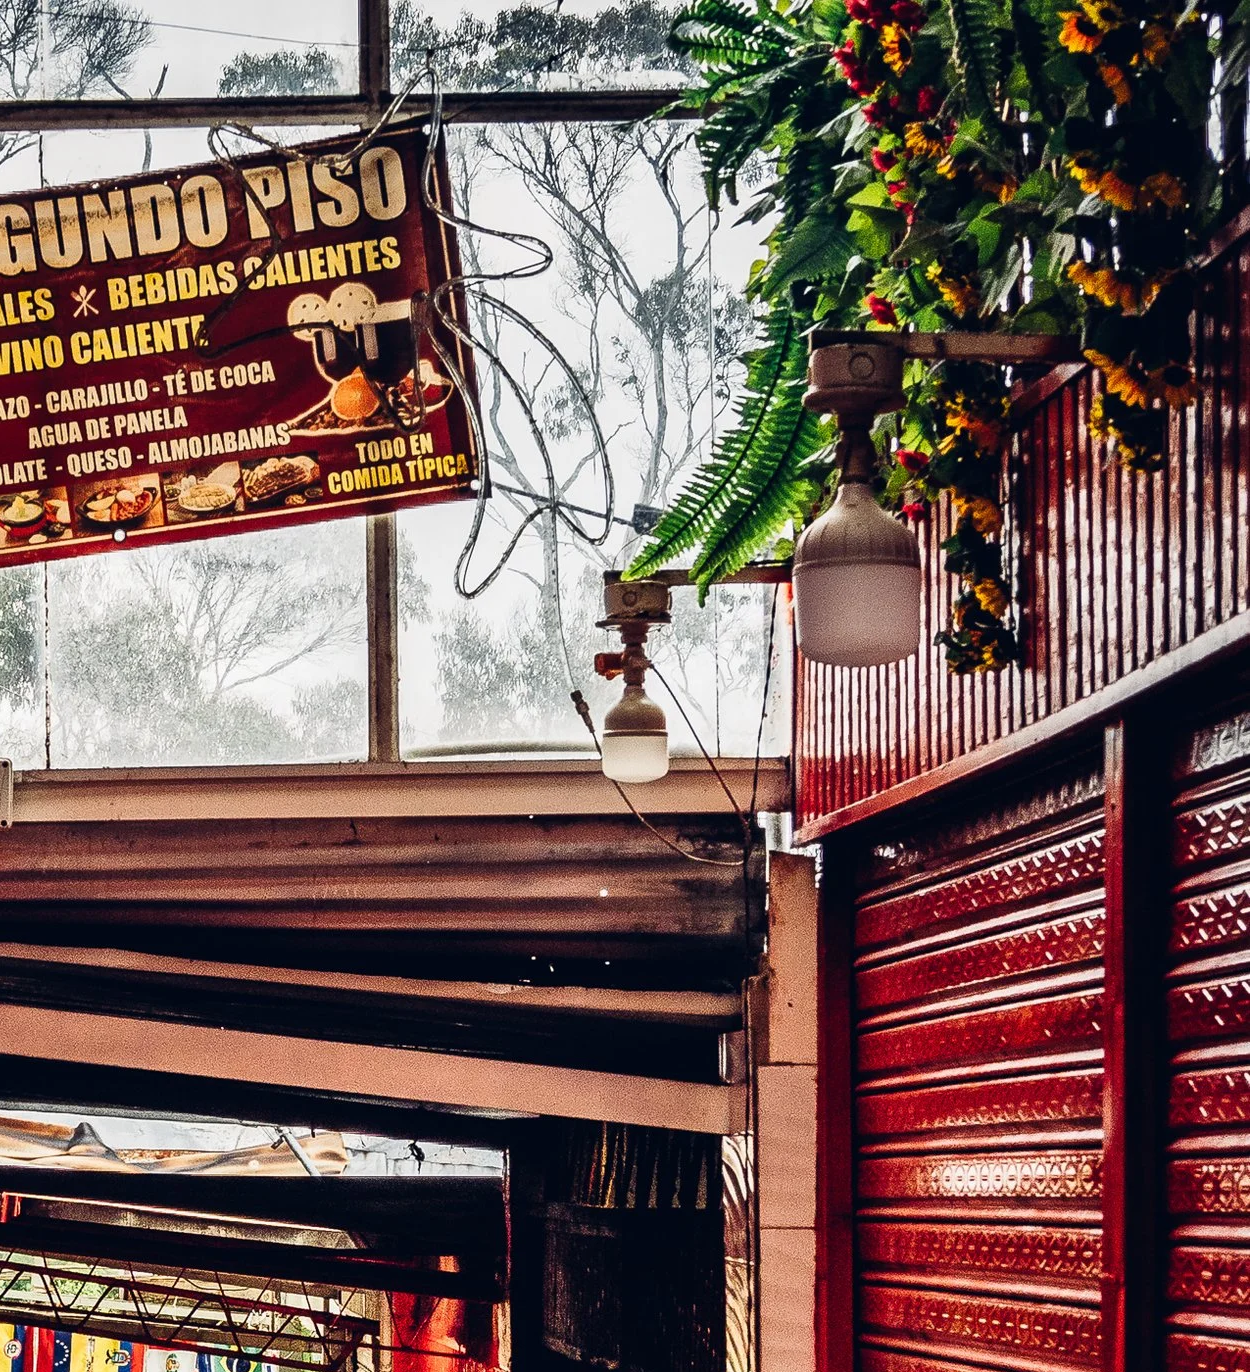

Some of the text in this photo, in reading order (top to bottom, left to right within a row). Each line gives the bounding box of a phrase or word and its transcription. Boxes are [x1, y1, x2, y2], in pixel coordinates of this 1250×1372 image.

[243, 146, 408, 239] PISO
[108, 263, 238, 310] BEBIDAS
[243, 237, 401, 290] CALIENTES
[47, 379, 148, 414] CARAJILLO
[163, 368, 186, 396] TÉ
[189, 368, 216, 392] DE
[219, 361, 275, 387] COCA
[28, 407, 187, 450] AGUA DE PANELA
[66, 447, 132, 477] QUESO
[148, 423, 291, 465] ALMOJABANAS
[356, 432, 434, 463] TODO EN
[328, 453, 468, 495] COMIDA TÍPICA
